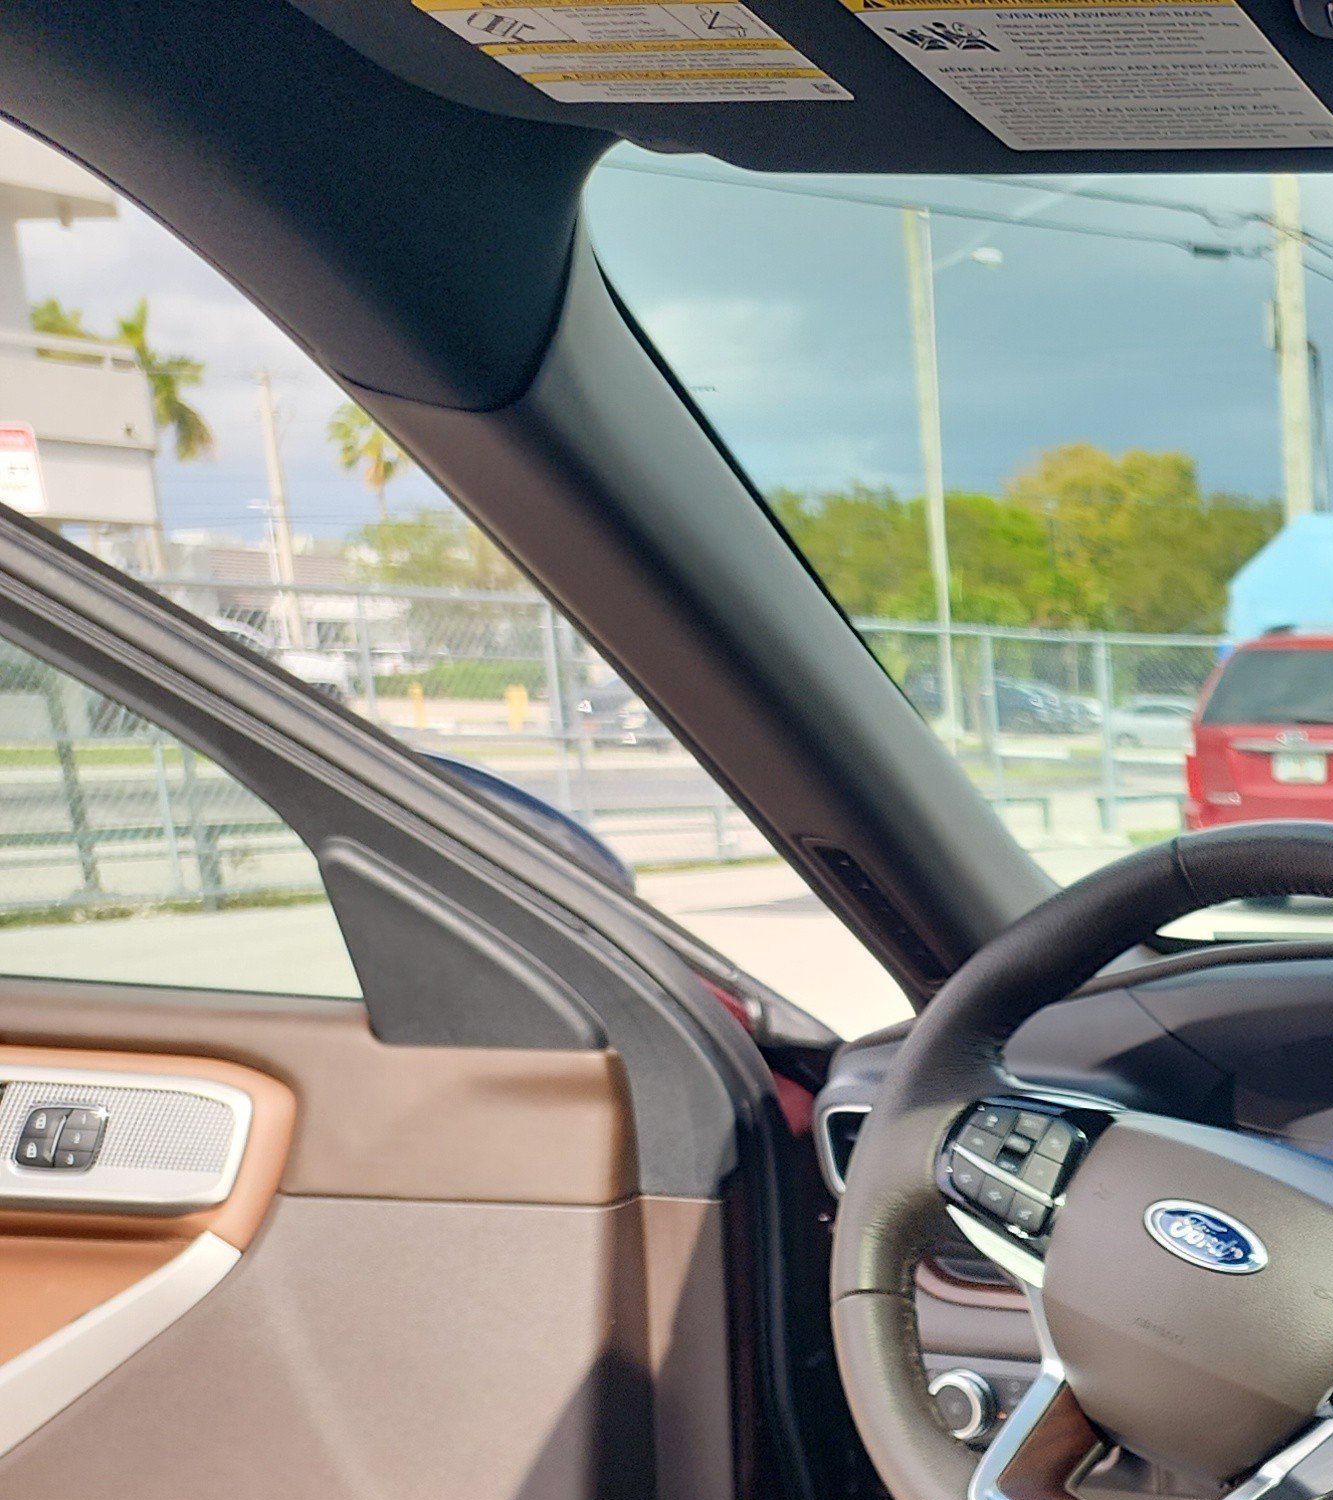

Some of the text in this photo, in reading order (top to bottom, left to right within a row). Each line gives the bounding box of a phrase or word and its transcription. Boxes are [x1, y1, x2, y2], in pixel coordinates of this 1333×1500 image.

[996, 12, 1033, 20] EVEN
[1073, 11, 1147, 19] ADVANCED
[1174, 10, 1213, 18] BAGS
[1168, 1213, 1244, 1262] Ford
